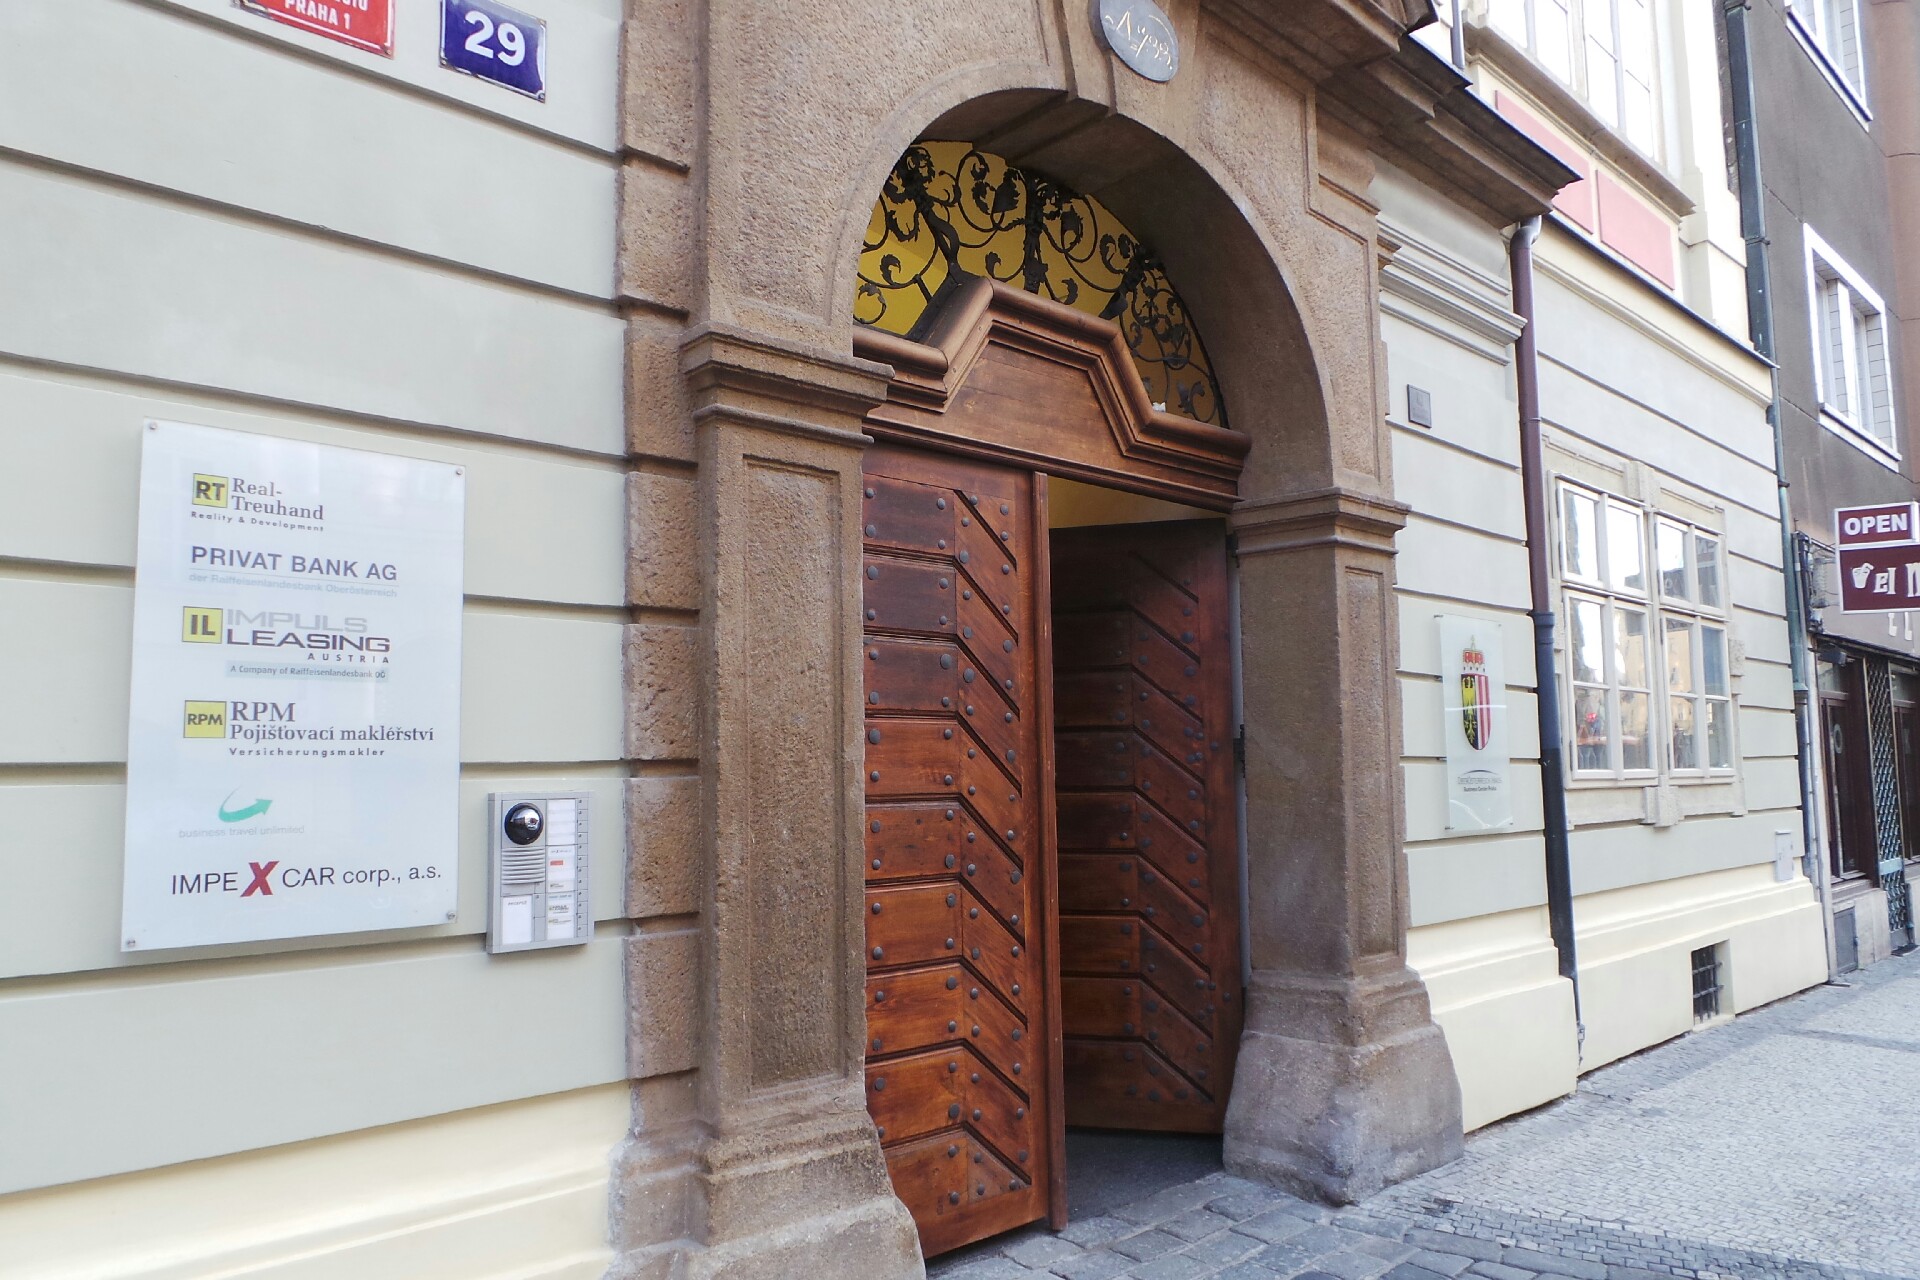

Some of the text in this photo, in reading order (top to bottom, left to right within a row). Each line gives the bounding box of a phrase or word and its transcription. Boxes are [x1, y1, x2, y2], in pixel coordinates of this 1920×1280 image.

[344, 13, 351, 30] 1
[465, 10, 525, 66] 29
[195, 480, 225, 501] RT
[232, 477, 283, 497] Real-
[231, 495, 324, 520] Treuhand
[191, 511, 232, 523] Reality
[251, 517, 324, 532] Development
[1844, 513, 1908, 536] OPEN
[191, 545, 397, 581] PRIVAT BANK AG
[189, 573, 208, 583] der
[211, 574, 323, 592] Raiffeisenlandesbank
[190, 614, 216, 636] IL
[227, 609, 368, 633] IMPULS
[226, 628, 391, 653] LEASING
[307, 652, 389, 664] AUSTRIA
[230, 665, 237, 673] A
[239, 665, 276, 676] Company
[279, 667, 288, 675] of
[290, 667, 373, 678] Raiffeisenlandesbank
[187, 713, 223, 726] RPM
[230, 701, 296, 722] RPM
[230, 724, 434, 744] Pojišťovací makléřství
[229, 748, 385, 758] Versicherungsmakler
[179, 825, 305, 838] business travel unlimited
[342, 869, 401, 887] corp.,
[408, 866, 442, 880] a.s.
